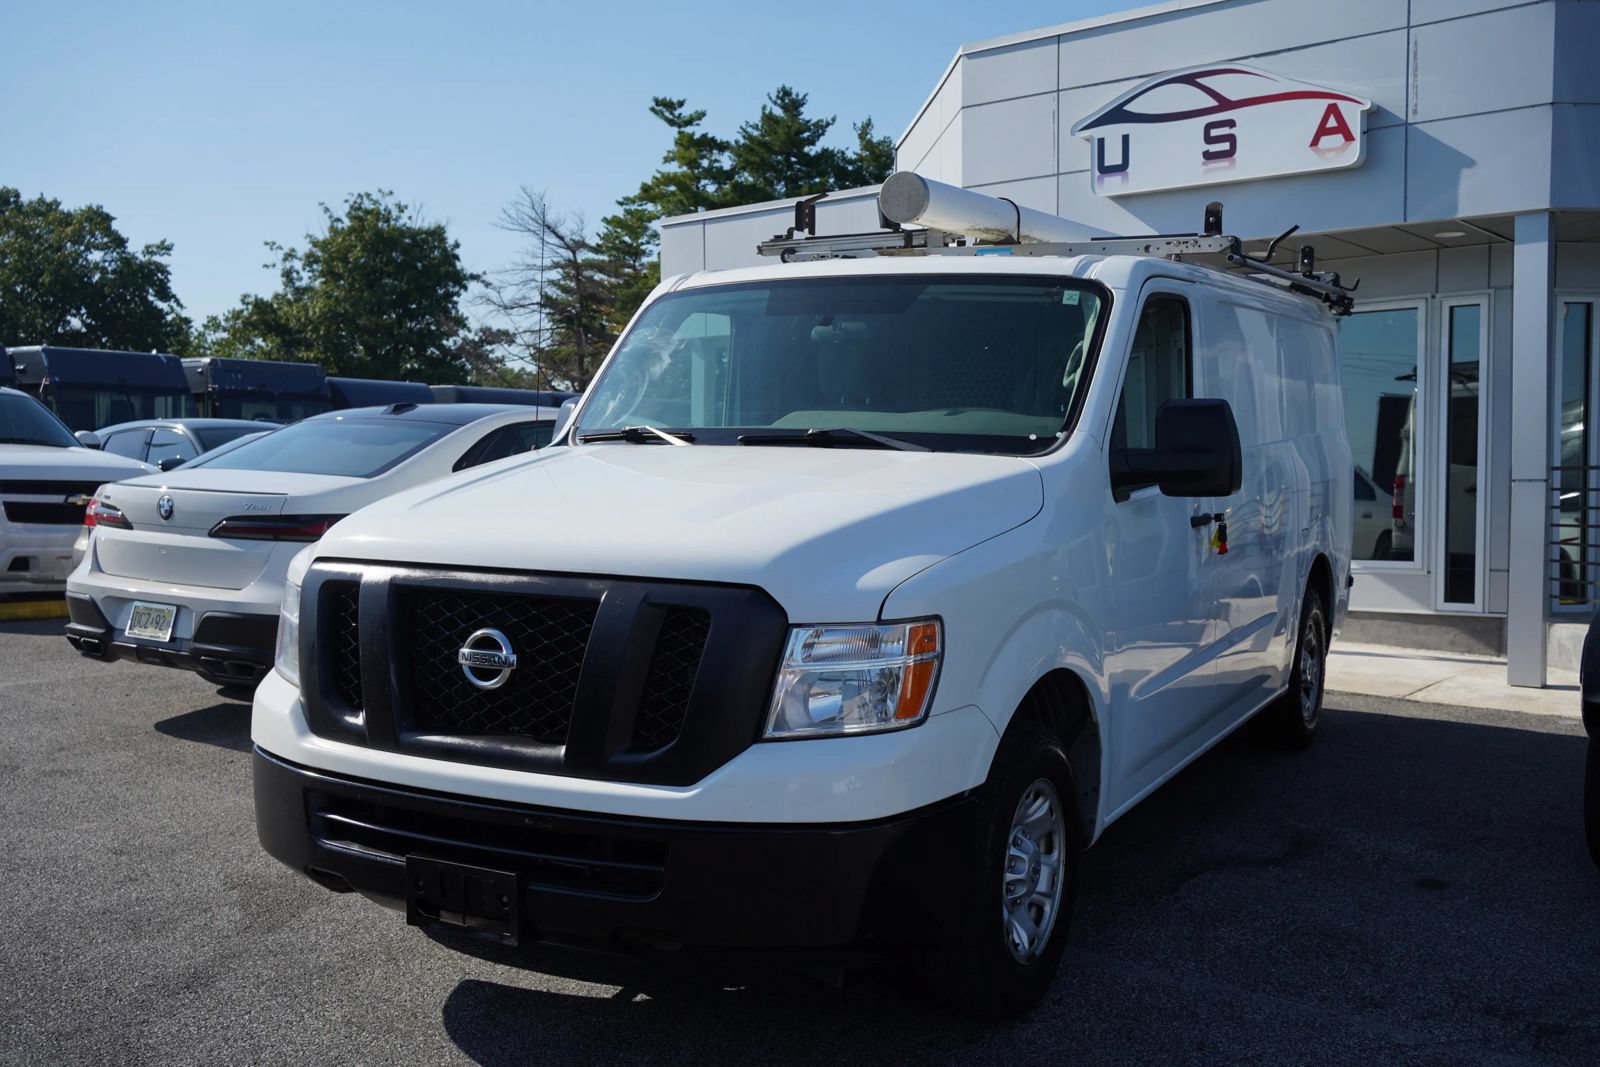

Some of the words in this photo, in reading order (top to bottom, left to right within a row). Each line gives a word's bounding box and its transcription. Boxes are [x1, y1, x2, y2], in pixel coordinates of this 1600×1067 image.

[1097, 134, 1130, 174] U
[1202, 118, 1237, 161] S
[1309, 102, 1356, 147] A
[461, 651, 508, 666] NISSAN
